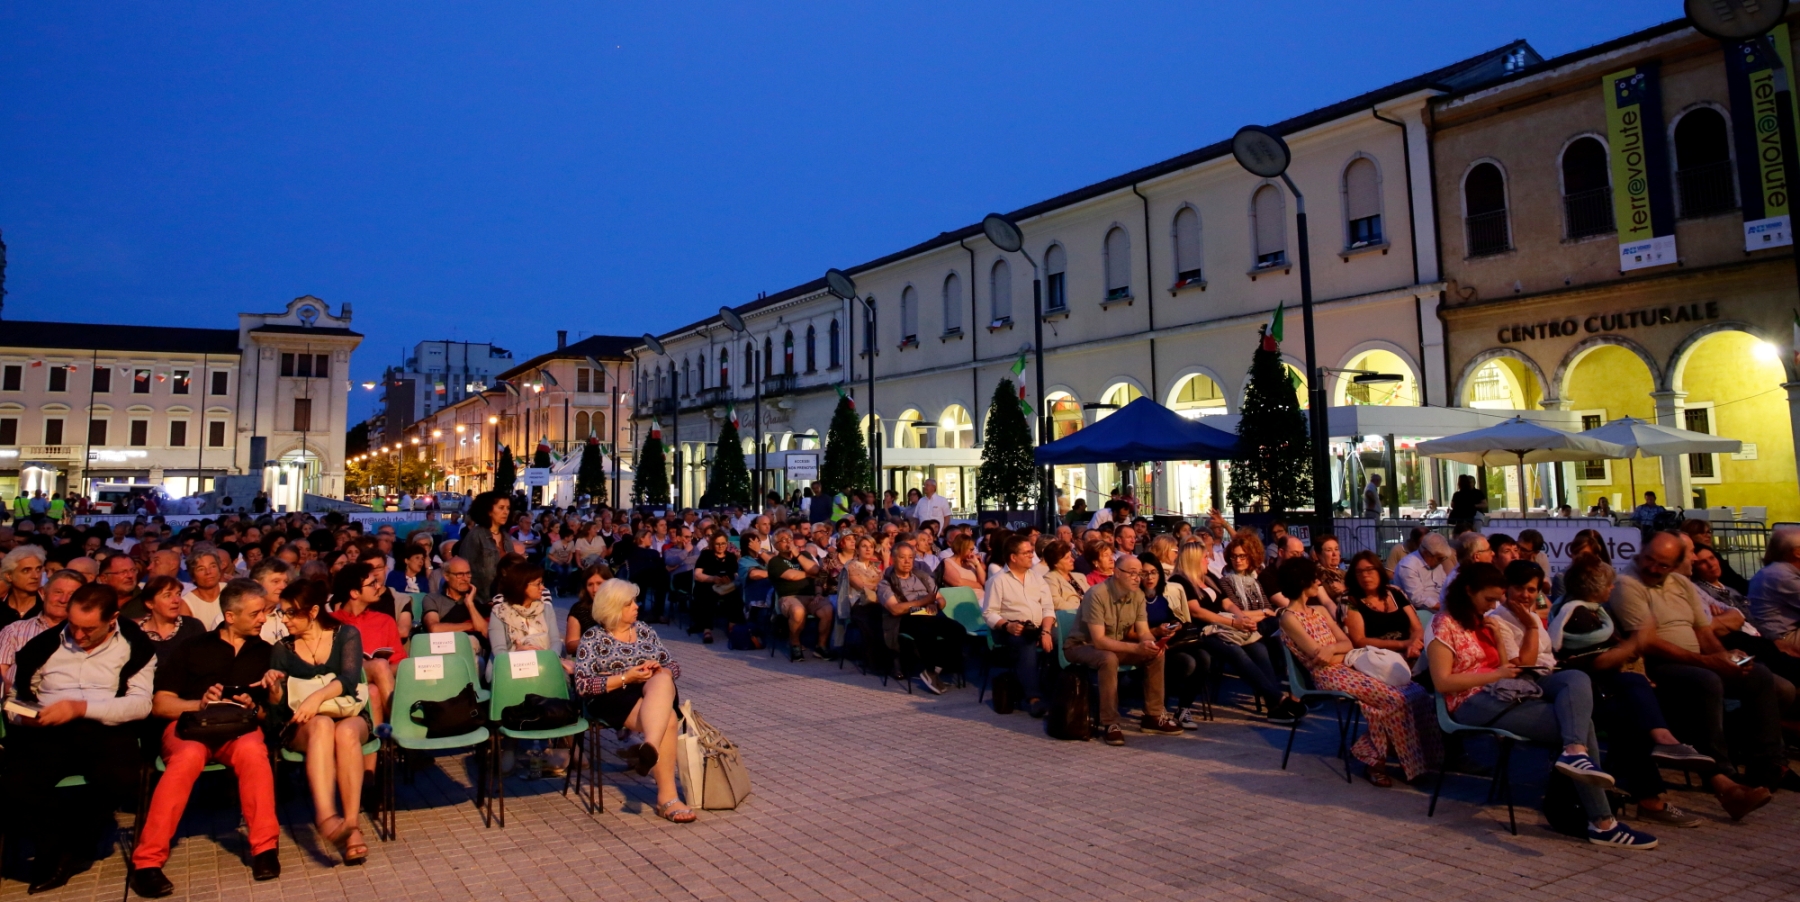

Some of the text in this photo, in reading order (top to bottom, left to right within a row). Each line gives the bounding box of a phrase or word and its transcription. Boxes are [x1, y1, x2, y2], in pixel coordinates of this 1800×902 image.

[1620, 111, 1648, 233] terr@volute
[1497, 301, 1720, 344] CENTRO CULTURALE
